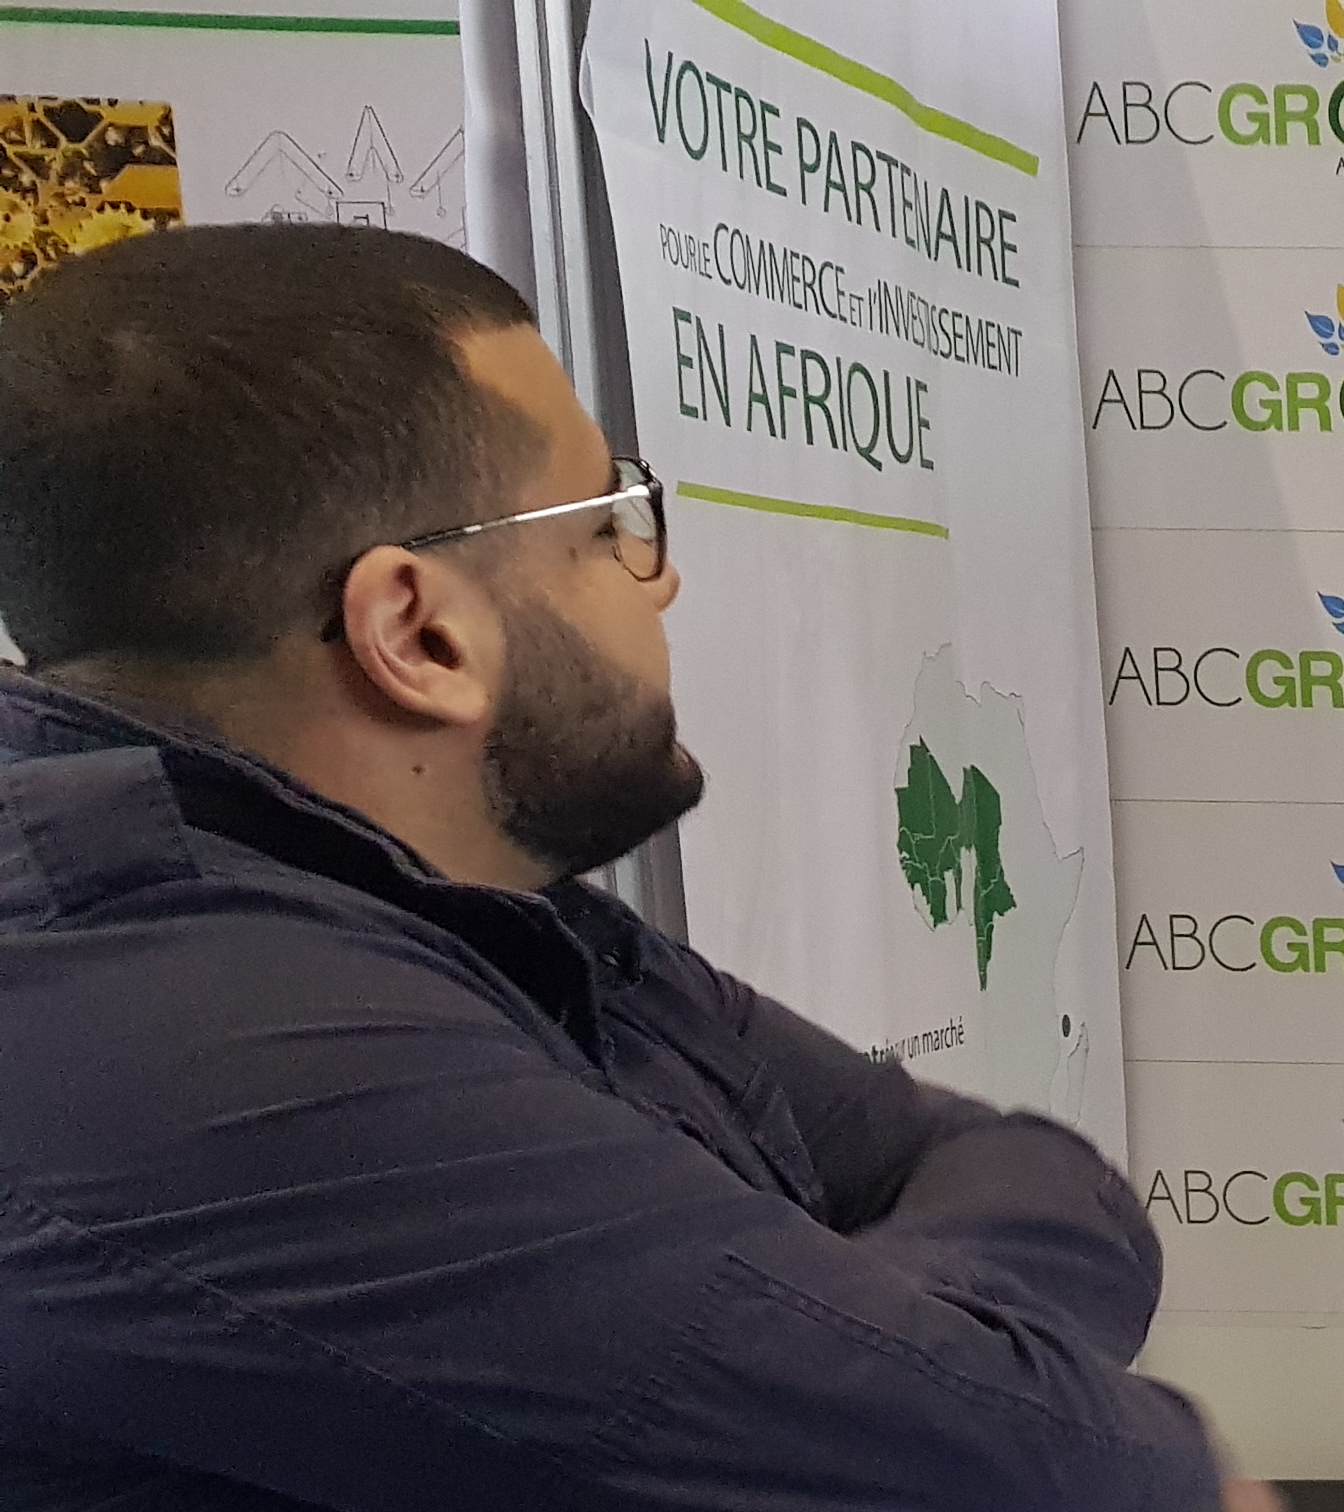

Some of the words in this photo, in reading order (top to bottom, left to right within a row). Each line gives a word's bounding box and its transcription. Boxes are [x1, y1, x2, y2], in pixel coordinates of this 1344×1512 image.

[644, 38, 787, 197] VOTRE
[796, 117, 1020, 288] PARTENAIRE
[660, 224, 696, 272] POUR
[697, 241, 712, 280] LE
[714, 223, 847, 324] COMMERCE
[672, 306, 731, 427] EN
[747, 334, 934, 472] AFRIQUE
[907, 1037, 921, 1059] un
[922, 1016, 965, 1053] marché
